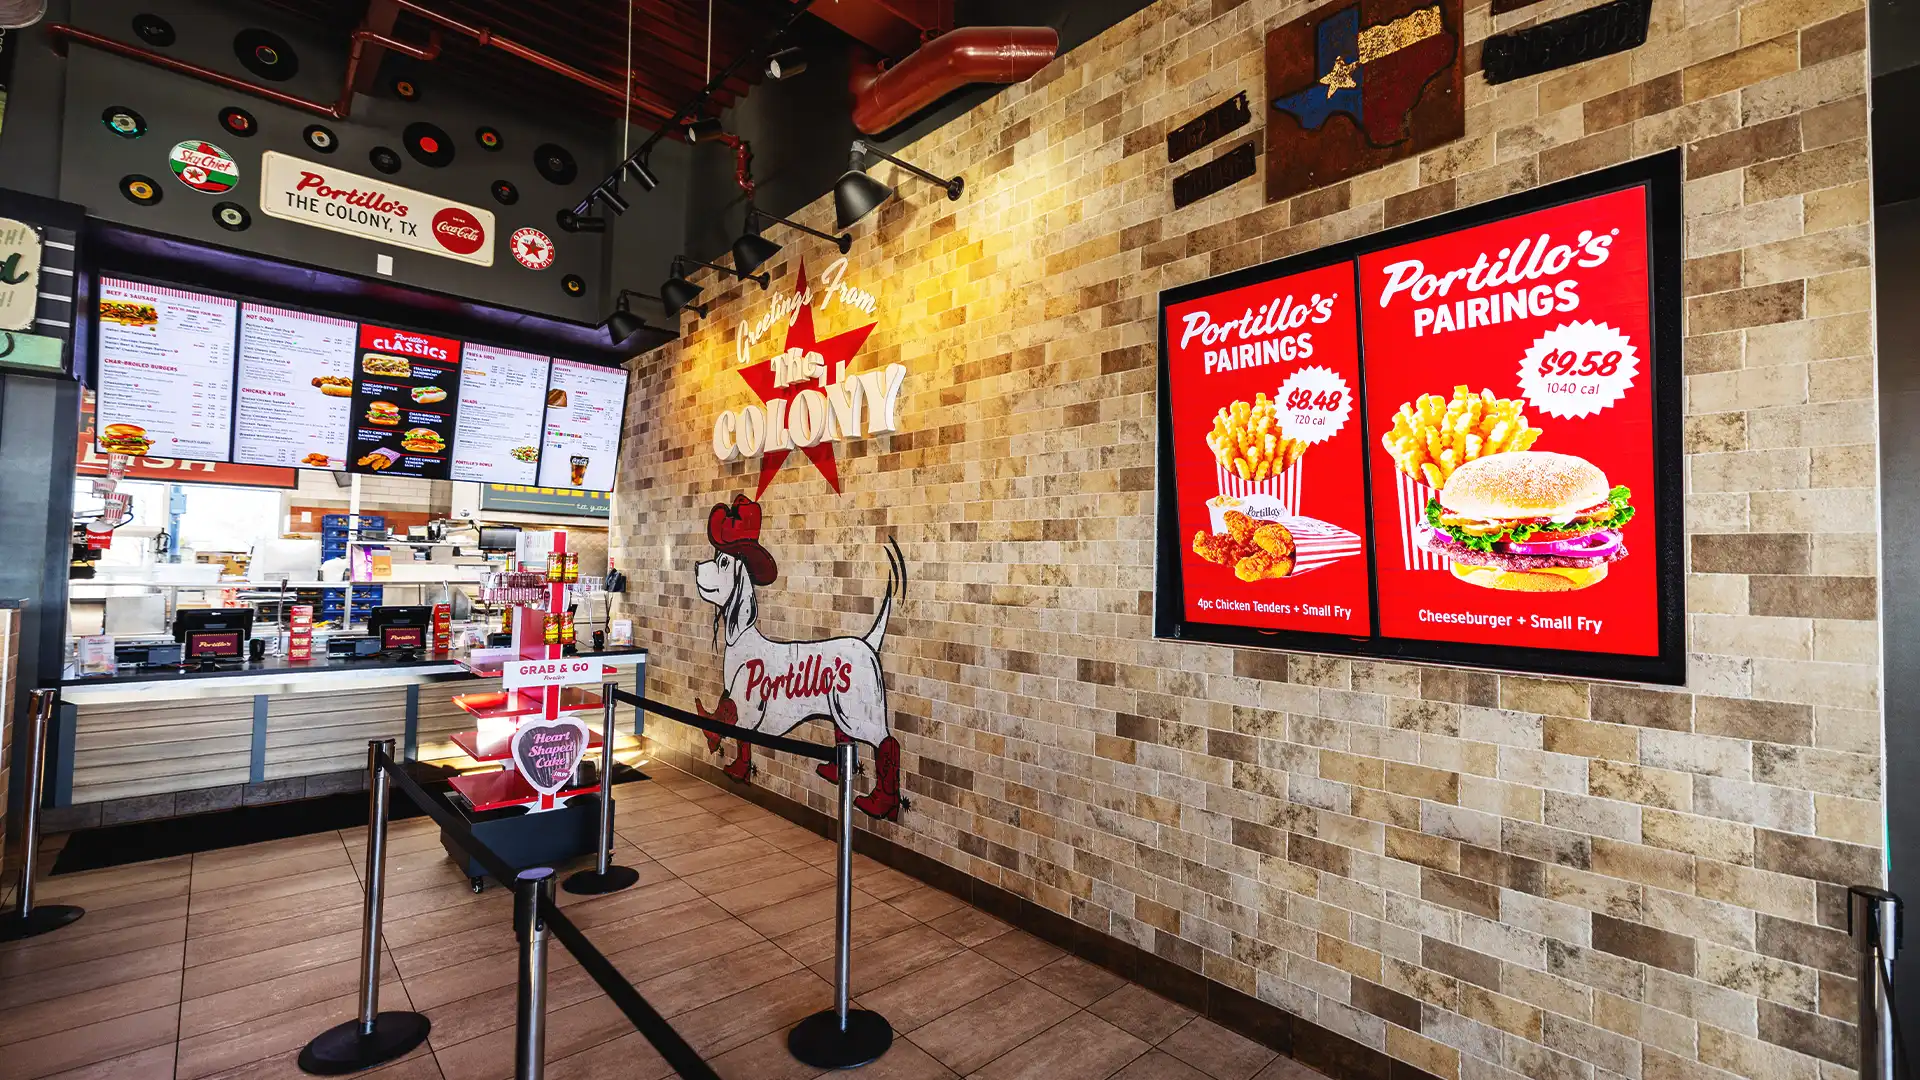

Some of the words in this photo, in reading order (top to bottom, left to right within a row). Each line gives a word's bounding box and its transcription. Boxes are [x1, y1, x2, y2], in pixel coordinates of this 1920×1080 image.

[180, 150, 201, 165] Sky
[202, 156, 231, 171] Chief
[296, 171, 408, 217] Portillo's
[286, 192, 319, 213] THE
[326, 202, 393, 232] COLONY,
[400, 220, 417, 237] TX
[514, 230, 552, 250] GASOLINE
[512, 248, 540, 268] MOTOR
[542, 258, 552, 267] OIL
[1379, 229, 1612, 308] Portillo's
[737, 285, 814, 364] Greetings
[820, 257, 877, 315] From
[1414, 279, 1580, 337] PAIRINGS
[1180, 293, 1333, 350] Portillo's
[372, 336, 447, 360] CLASSICS
[393, 332, 428, 345] Portillo's
[1204, 332, 1313, 375] PAIRINGS
[1538, 348, 1621, 378] $9.58
[150, 364, 177, 372] BURGERS
[770, 347, 824, 389] The
[1286, 387, 1342, 412] $8.48
[1546, 382, 1577, 395] 1040
[1580, 382, 1600, 395] cal
[713, 360, 906, 462] COLONY
[1294, 414, 1308, 425] 720
[1310, 415, 1326, 426] cal
[1247, 505, 1280, 517] Portillo's
[1197, 597, 1214, 611] 4pc
[1215, 598, 1251, 612] Chicken
[1252, 600, 1291, 615] Tenders
[1302, 604, 1331, 617] Small
[1334, 605, 1352, 621] Fry
[1418, 608, 1513, 629] Cheeseburger
[1517, 616, 1527, 626] +
[1530, 614, 1572, 630] Small
[1577, 617, 1602, 634] Fry
[520, 664, 555, 675] GRAB
[560, 664, 567, 672] &
[572, 663, 589, 672] GO
[746, 654, 852, 702] Portillo's
[528, 742, 574, 757] Shaped
[533, 732, 570, 744] Heart
[536, 757, 565, 768] Cake
